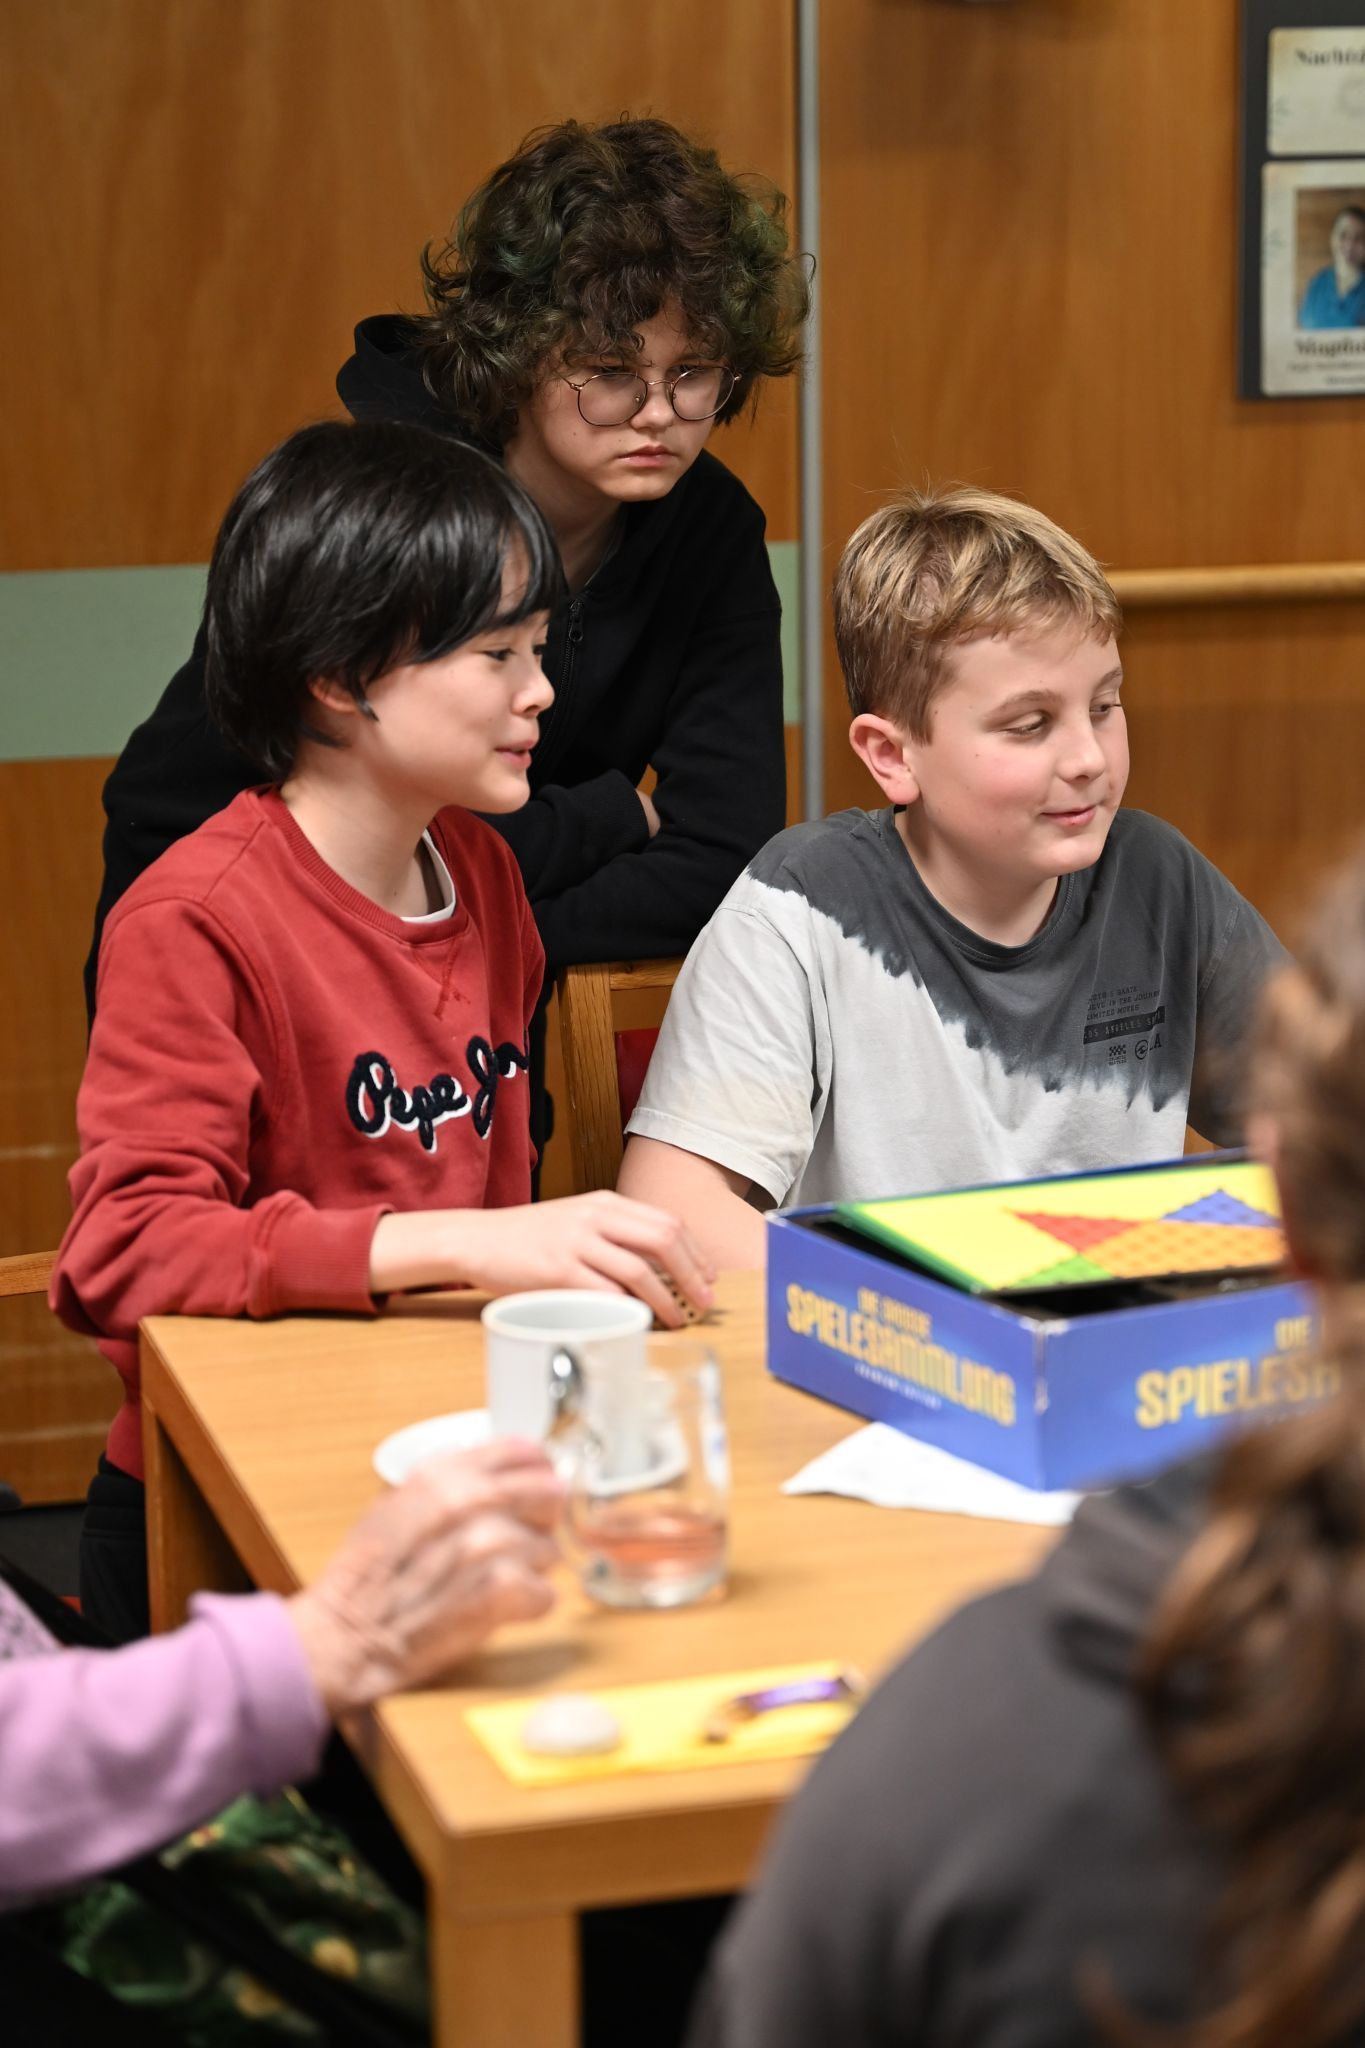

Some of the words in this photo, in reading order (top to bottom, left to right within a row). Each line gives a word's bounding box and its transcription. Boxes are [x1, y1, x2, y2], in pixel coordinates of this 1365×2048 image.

[346, 1051, 472, 1154] Pepe
[786, 1282, 1017, 1428] SPIELESAMMLUNG
[1136, 1355, 1342, 1430] SPIELESA
